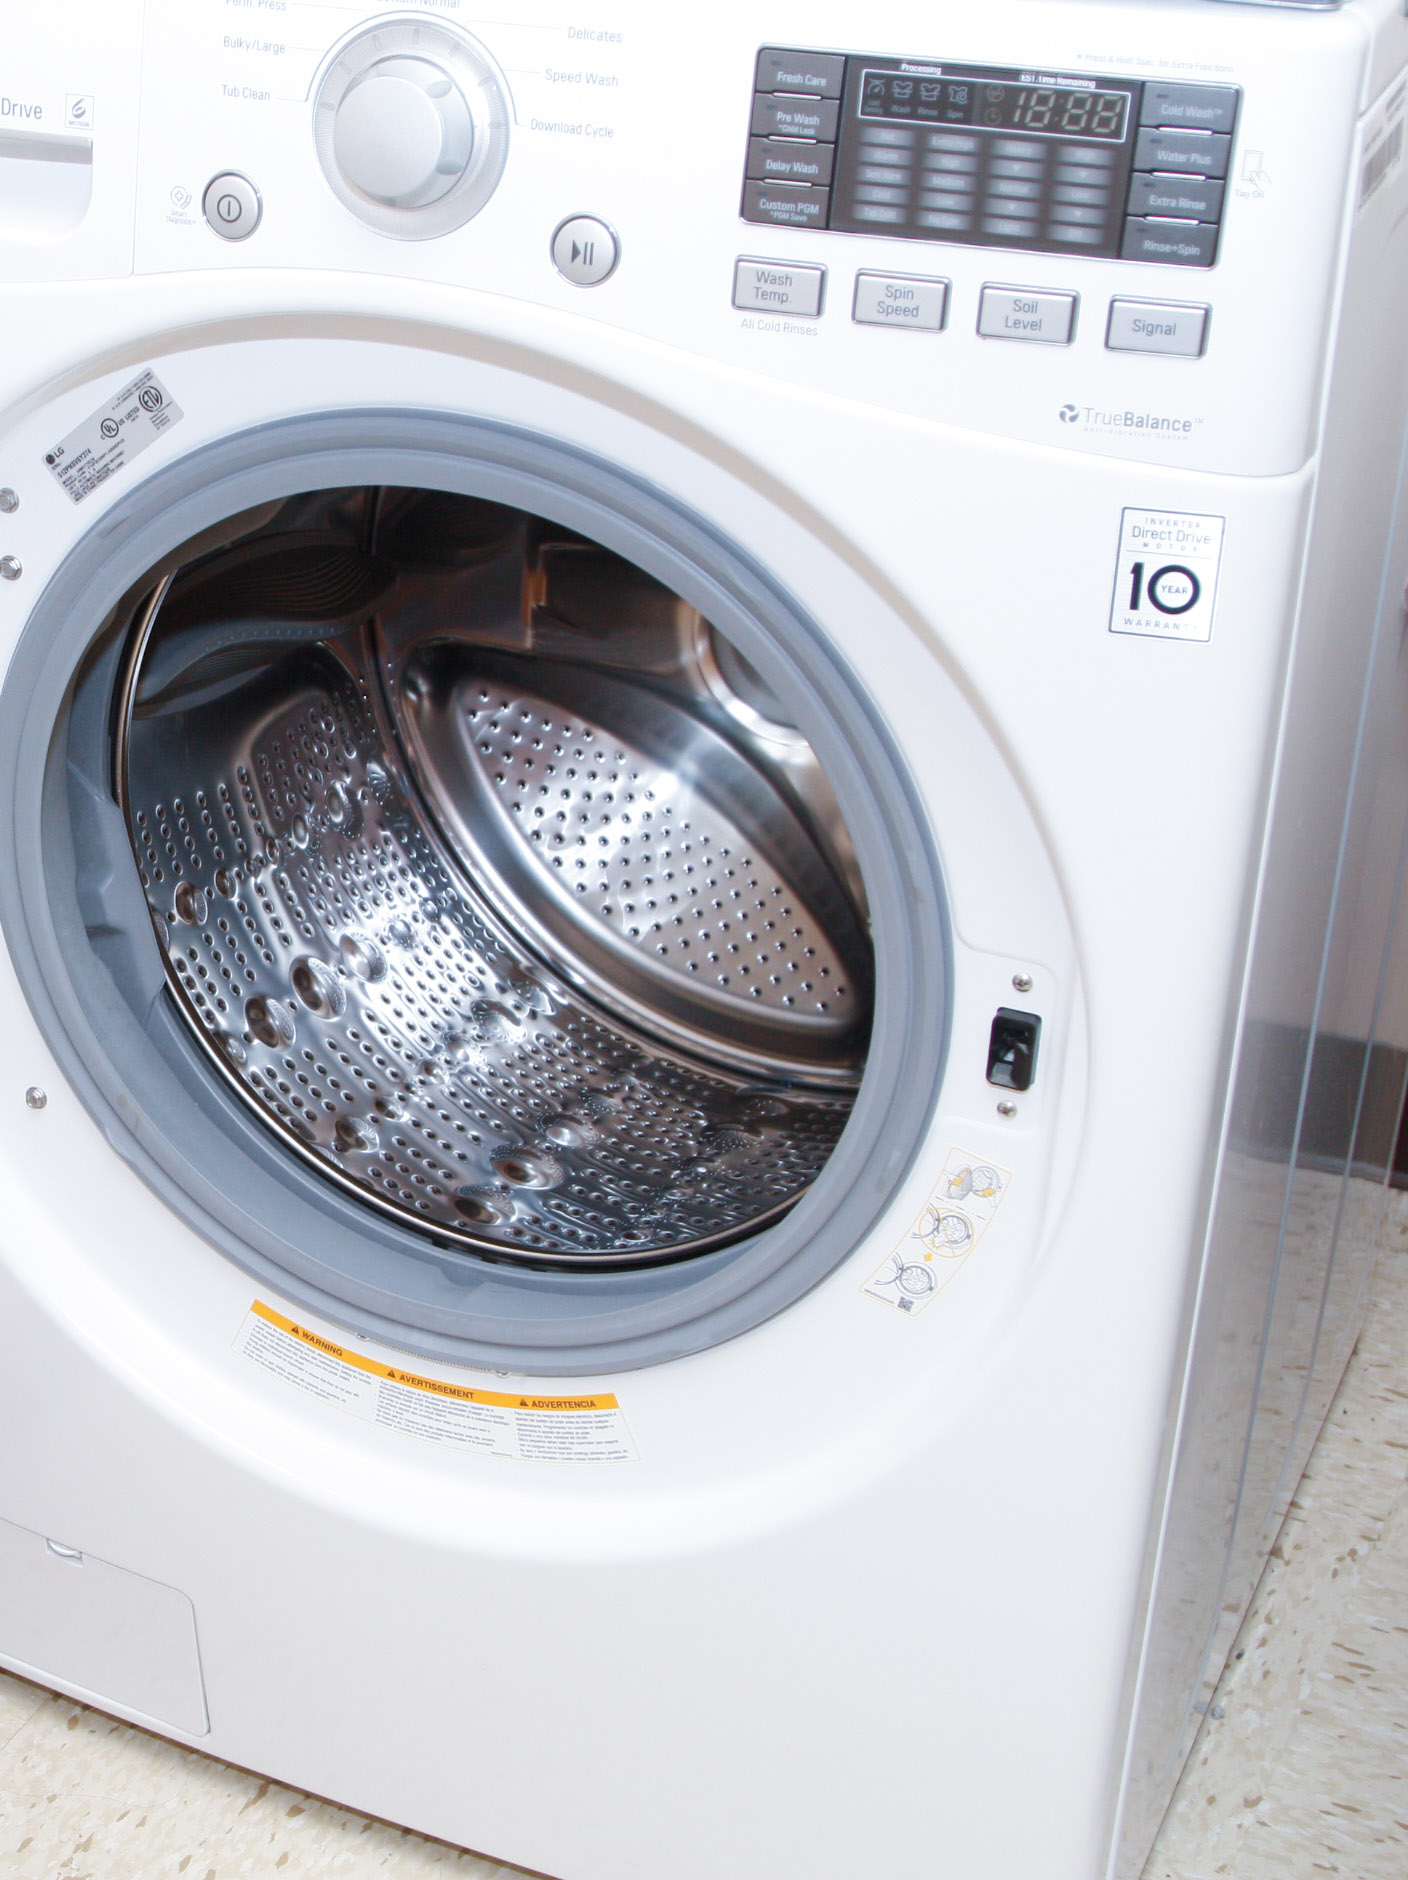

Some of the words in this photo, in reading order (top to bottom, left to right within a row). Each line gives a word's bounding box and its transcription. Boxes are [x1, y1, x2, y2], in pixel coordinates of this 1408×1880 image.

[258, 0, 287, 11] Press
[567, 26, 623, 43] Delicates
[223, 35, 286, 55] Bulky/Large
[901, 62, 942, 75] Processing
[545, 68, 582, 84] Speed
[585, 72, 619, 87] Wash
[776, 71, 804, 84] Fresh
[805, 75, 827, 87] Care
[1056, 77, 1097, 89] Remaining
[221, 84, 240, 97] Tub
[242, 87, 271, 101] Clean
[1, 97, 43, 120] Drive
[1161, 104, 1184, 116] Cold
[776, 111, 792, 123] Pre
[793, 114, 820, 126] Wash
[530, 118, 582, 135] Download
[585, 123, 614, 139] Cycle
[1156, 149, 1188, 163] Water
[1190, 153, 1213, 166] Plus
[766, 159, 792, 173] Delay
[792, 162, 819, 175] Wash
[760, 198, 796, 212] Custom
[797, 202, 820, 215] PGM
[1149, 194, 1176, 207] Extra
[1178, 197, 1207, 210] Rinse
[1143, 240, 1201, 257] Rinse+Spin
[755, 269, 794, 287] Wash
[753, 286, 793, 306] Temp.
[884, 284, 915, 302] Spin
[876, 300, 920, 318] Speed
[1012, 298, 1039, 315] Soil
[740, 317, 756, 329] All
[757, 319, 781, 333] Cold
[783, 322, 819, 336] Rinses
[1004, 315, 1042, 332] Level
[1131, 319, 1177, 337] Signal
[124, 406, 140, 421] LISTED
[54, 447, 65, 459] LG
[1144, 517, 1201, 529] INVERTER
[1131, 525, 1173, 542] Direct
[1175, 530, 1212, 545] Drive
[1129, 561, 1203, 616] 10
[1160, 584, 1189, 595] YEAR
[300, 1330, 344, 1358] WARNING
[399, 1374, 475, 1400] AVERTISSEMENT
[531, 1400, 598, 1410] ADVERTENCIA
